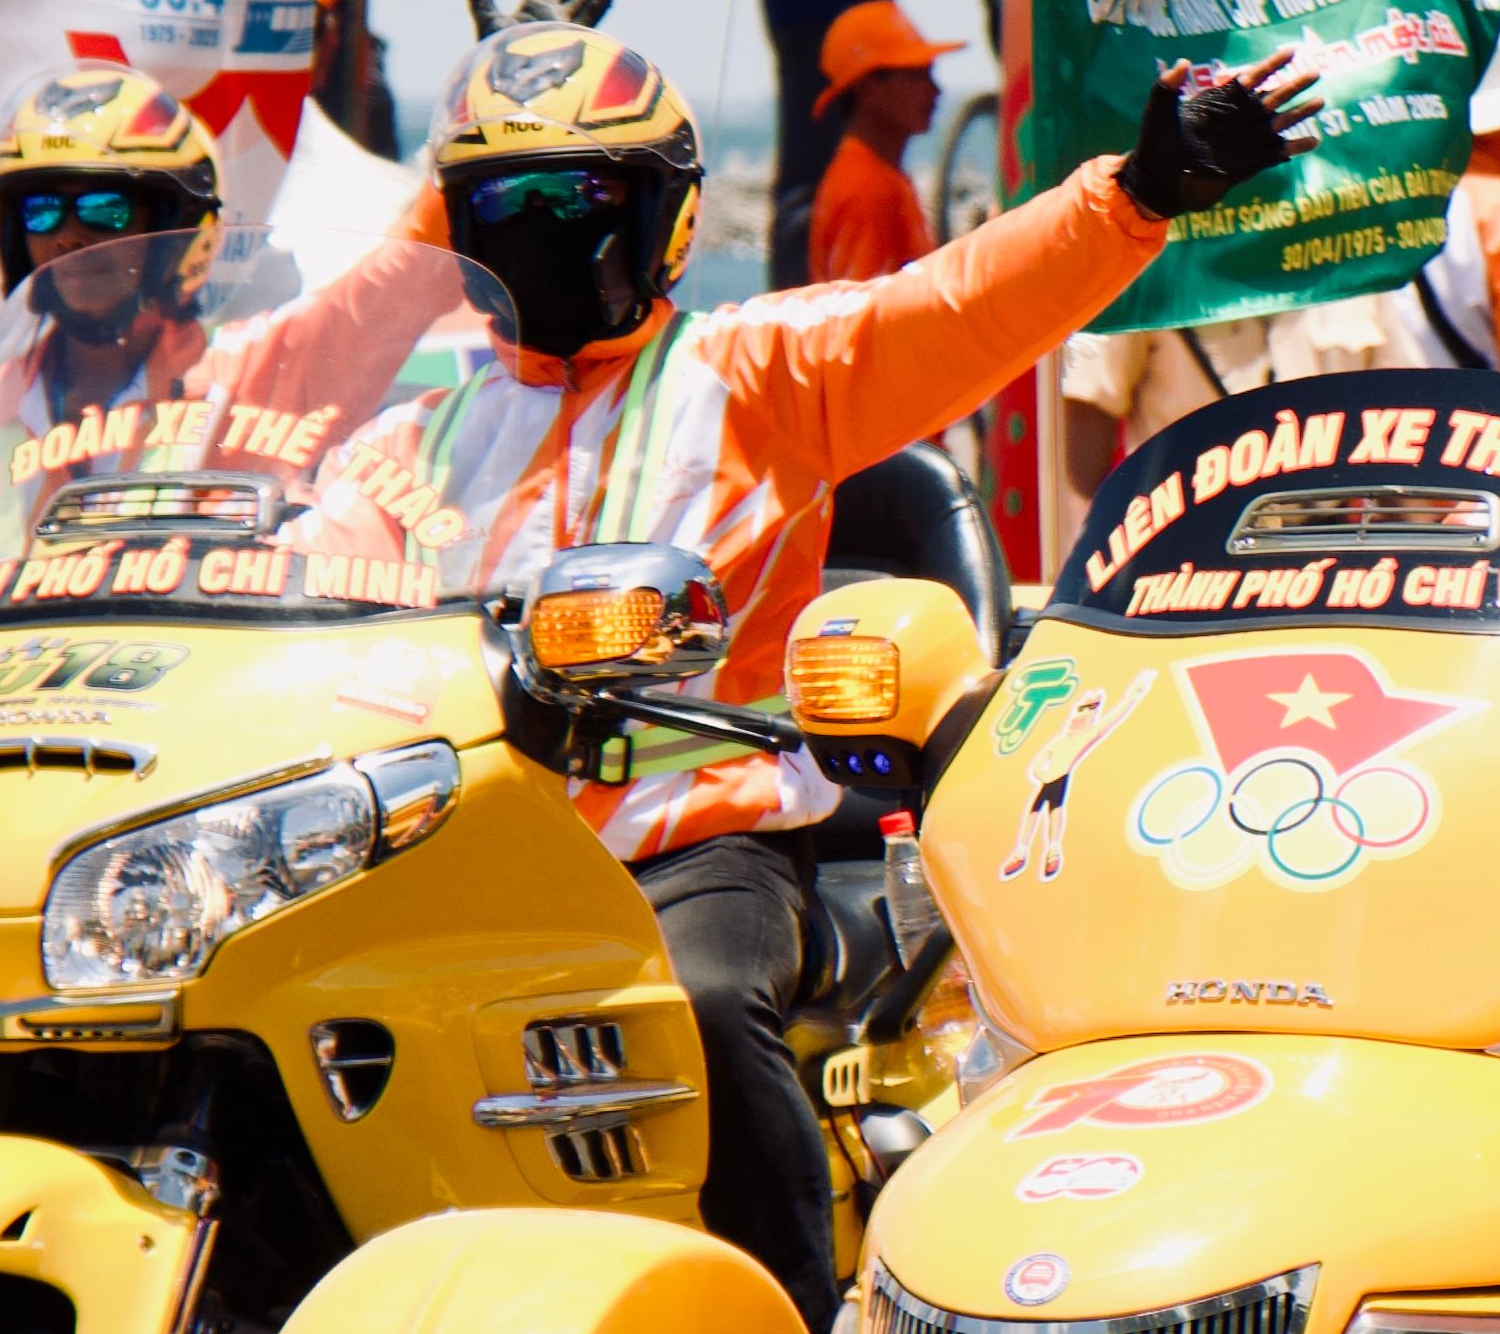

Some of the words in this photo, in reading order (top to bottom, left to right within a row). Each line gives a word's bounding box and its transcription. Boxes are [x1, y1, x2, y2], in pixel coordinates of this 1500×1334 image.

[1280, 227, 1386, 272] 30/04/1975
[9, 402, 145, 486] ĐOÀN
[144, 400, 214, 448] XE
[223, 403, 341, 468] THỂ
[335, 440, 467, 552] THAO
[1083, 479, 1185, 593] LIÊN
[1191, 410, 1347, 507] ĐOÀN
[1351, 408, 1434, 465] XE
[11, 539, 126, 601] PHỐ
[112, 536, 192, 597] HỒ
[197, 547, 292, 597] CHÍ
[303, 552, 438, 611] MINH
[1126, 562, 1240, 618] THÀNH
[1233, 557, 1339, 610] PHỐ
[1332, 555, 1400, 607] HỒ
[1404, 559, 1488, 608] CHÍ
[1164, 978, 1336, 1008] HONDA
